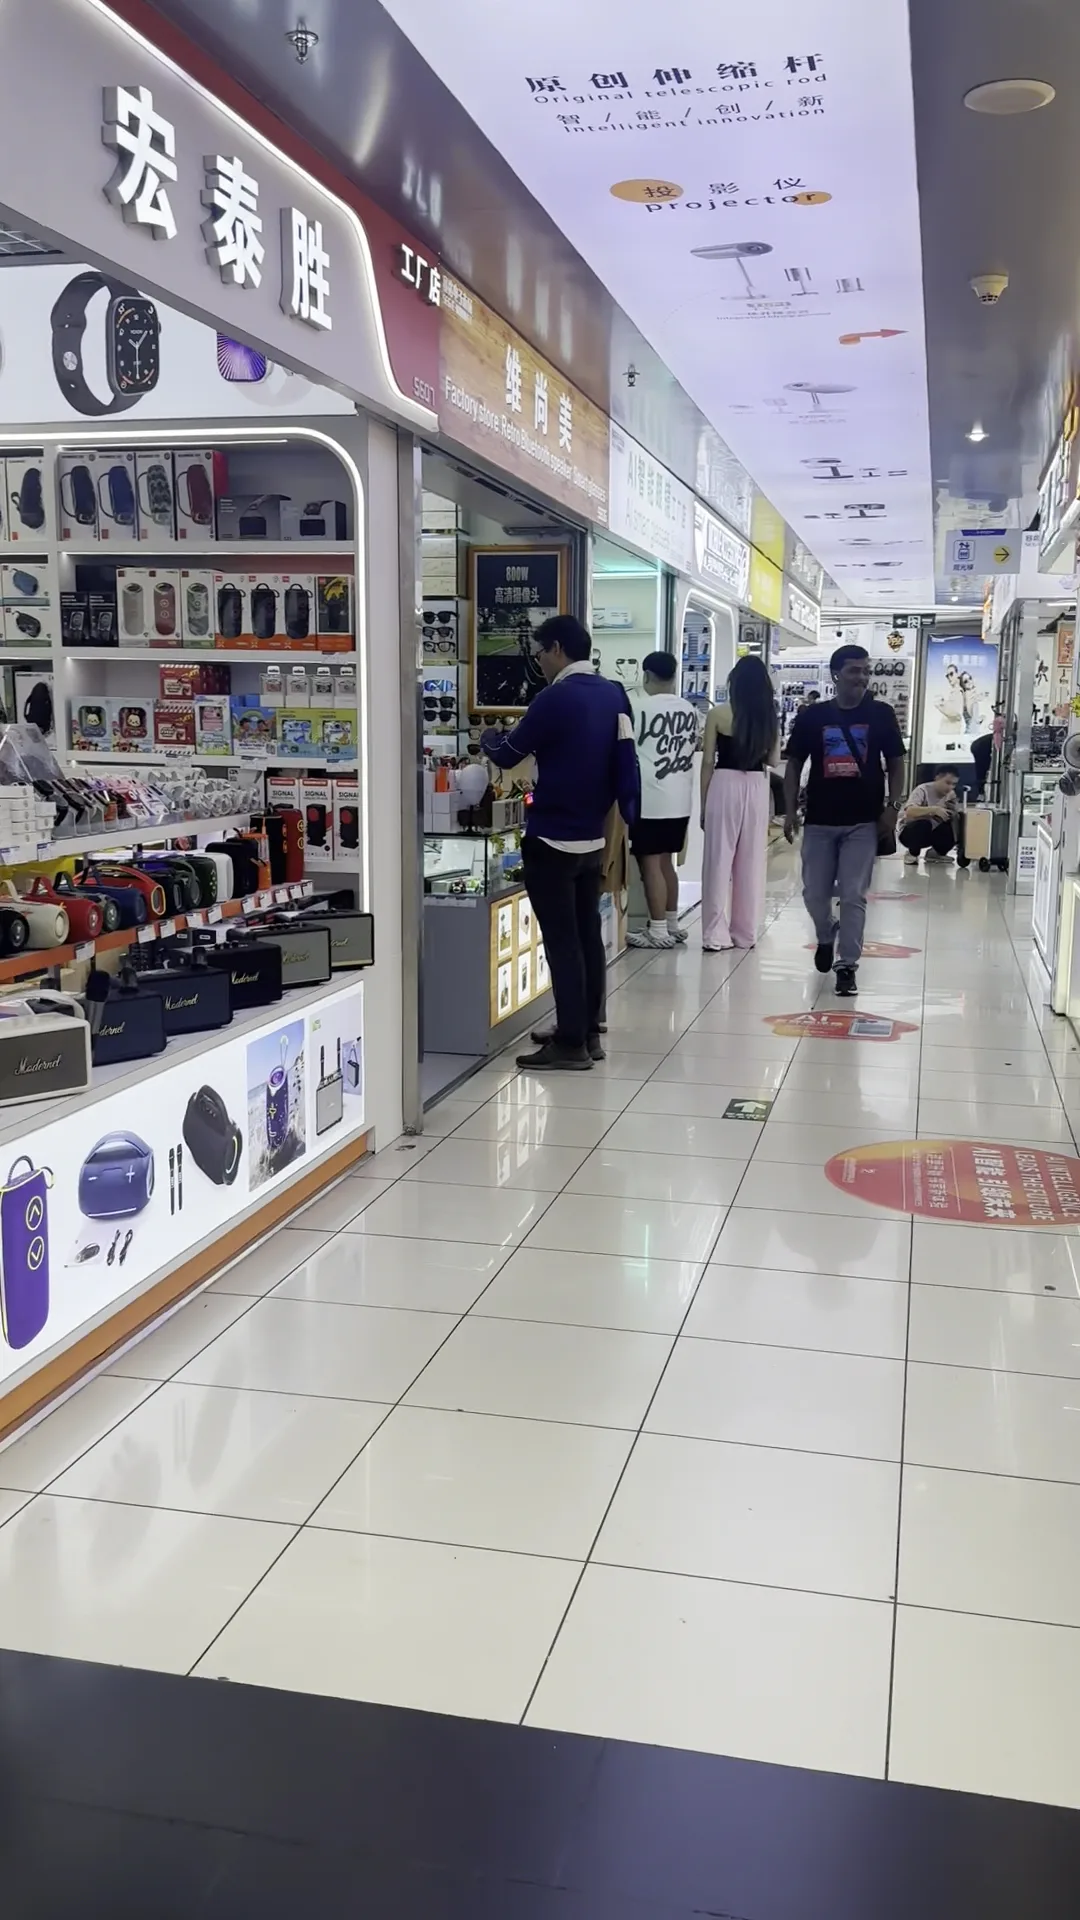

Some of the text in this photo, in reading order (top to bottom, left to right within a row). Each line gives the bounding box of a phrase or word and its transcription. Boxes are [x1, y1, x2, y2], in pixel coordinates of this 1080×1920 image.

[525, 53, 825, 94] 原创伸缩杆
[534, 72, 828, 105] Original telescopic rod
[564, 107, 825, 134] Intelligent innovation
[643, 176, 806, 200] 投影仪
[103, 86, 333, 331] 宏泰胜
[645, 190, 817, 214] projector
[401, 243, 441, 307] 工厂店
[445, 376, 478, 422] Factory
[478, 402, 500, 433] store
[501, 414, 521, 447] Retro
[505, 343, 573, 454] 维尚美
[506, 566, 529, 581] 800W
[656, 733, 687, 758] CITY
[164, 993, 199, 1011] Modernel
[99, 1021, 126, 1037] dernel
[14, 1054, 62, 1076] Modernel
[1014, 1151, 1056, 1221] LEADS THE FUTURE
